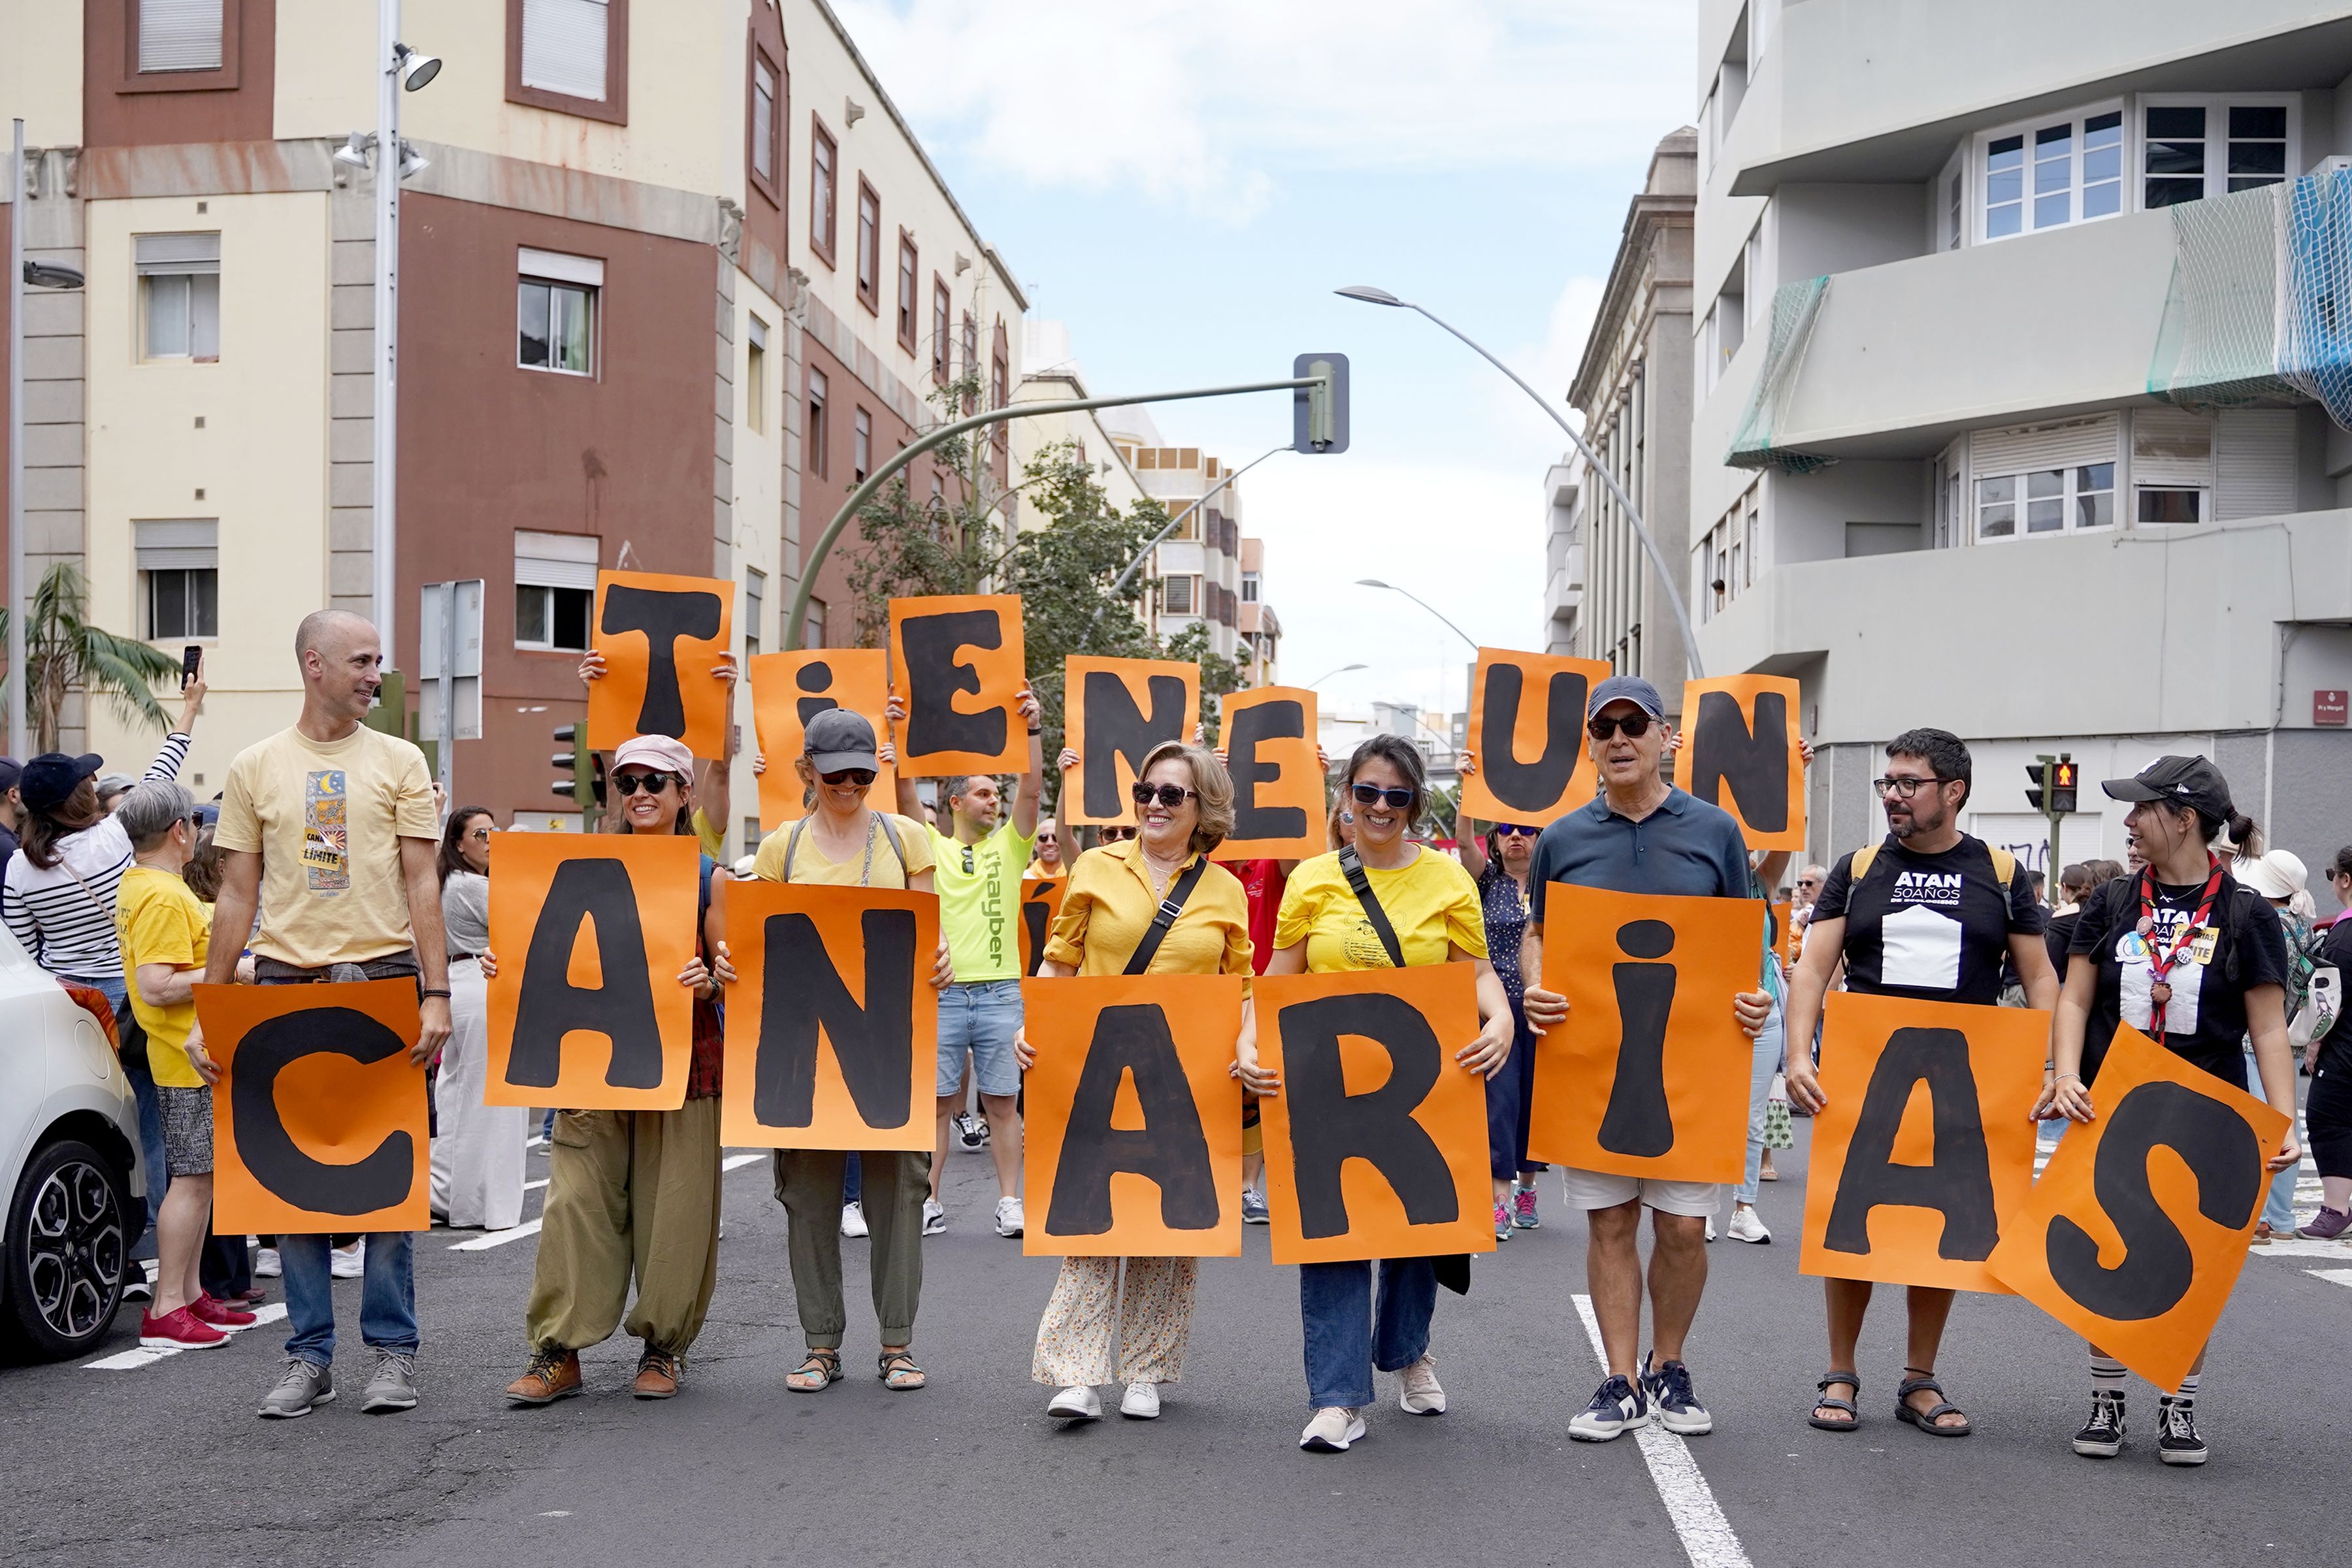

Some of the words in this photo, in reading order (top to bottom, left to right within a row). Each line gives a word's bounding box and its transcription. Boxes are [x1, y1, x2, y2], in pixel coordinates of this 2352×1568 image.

[602, 584, 722, 740] T
[901, 610, 1007, 758] E
[1482, 663, 1588, 811] U
[1084, 672, 1186, 818] N
[1226, 700, 1307, 840] E
[1691, 691, 1789, 833] N
[1895, 872, 1961, 888] ATAN
[2178, 930, 2215, 941] CRIAS
[504, 858, 663, 1089] A
[753, 909, 917, 1129] N
[231, 1006, 414, 1216] C
[1045, 1003, 1220, 1236] A
[1278, 992, 1459, 1239] R
[1823, 1026, 2000, 1262] A
[2046, 1081, 2262, 1321] S
